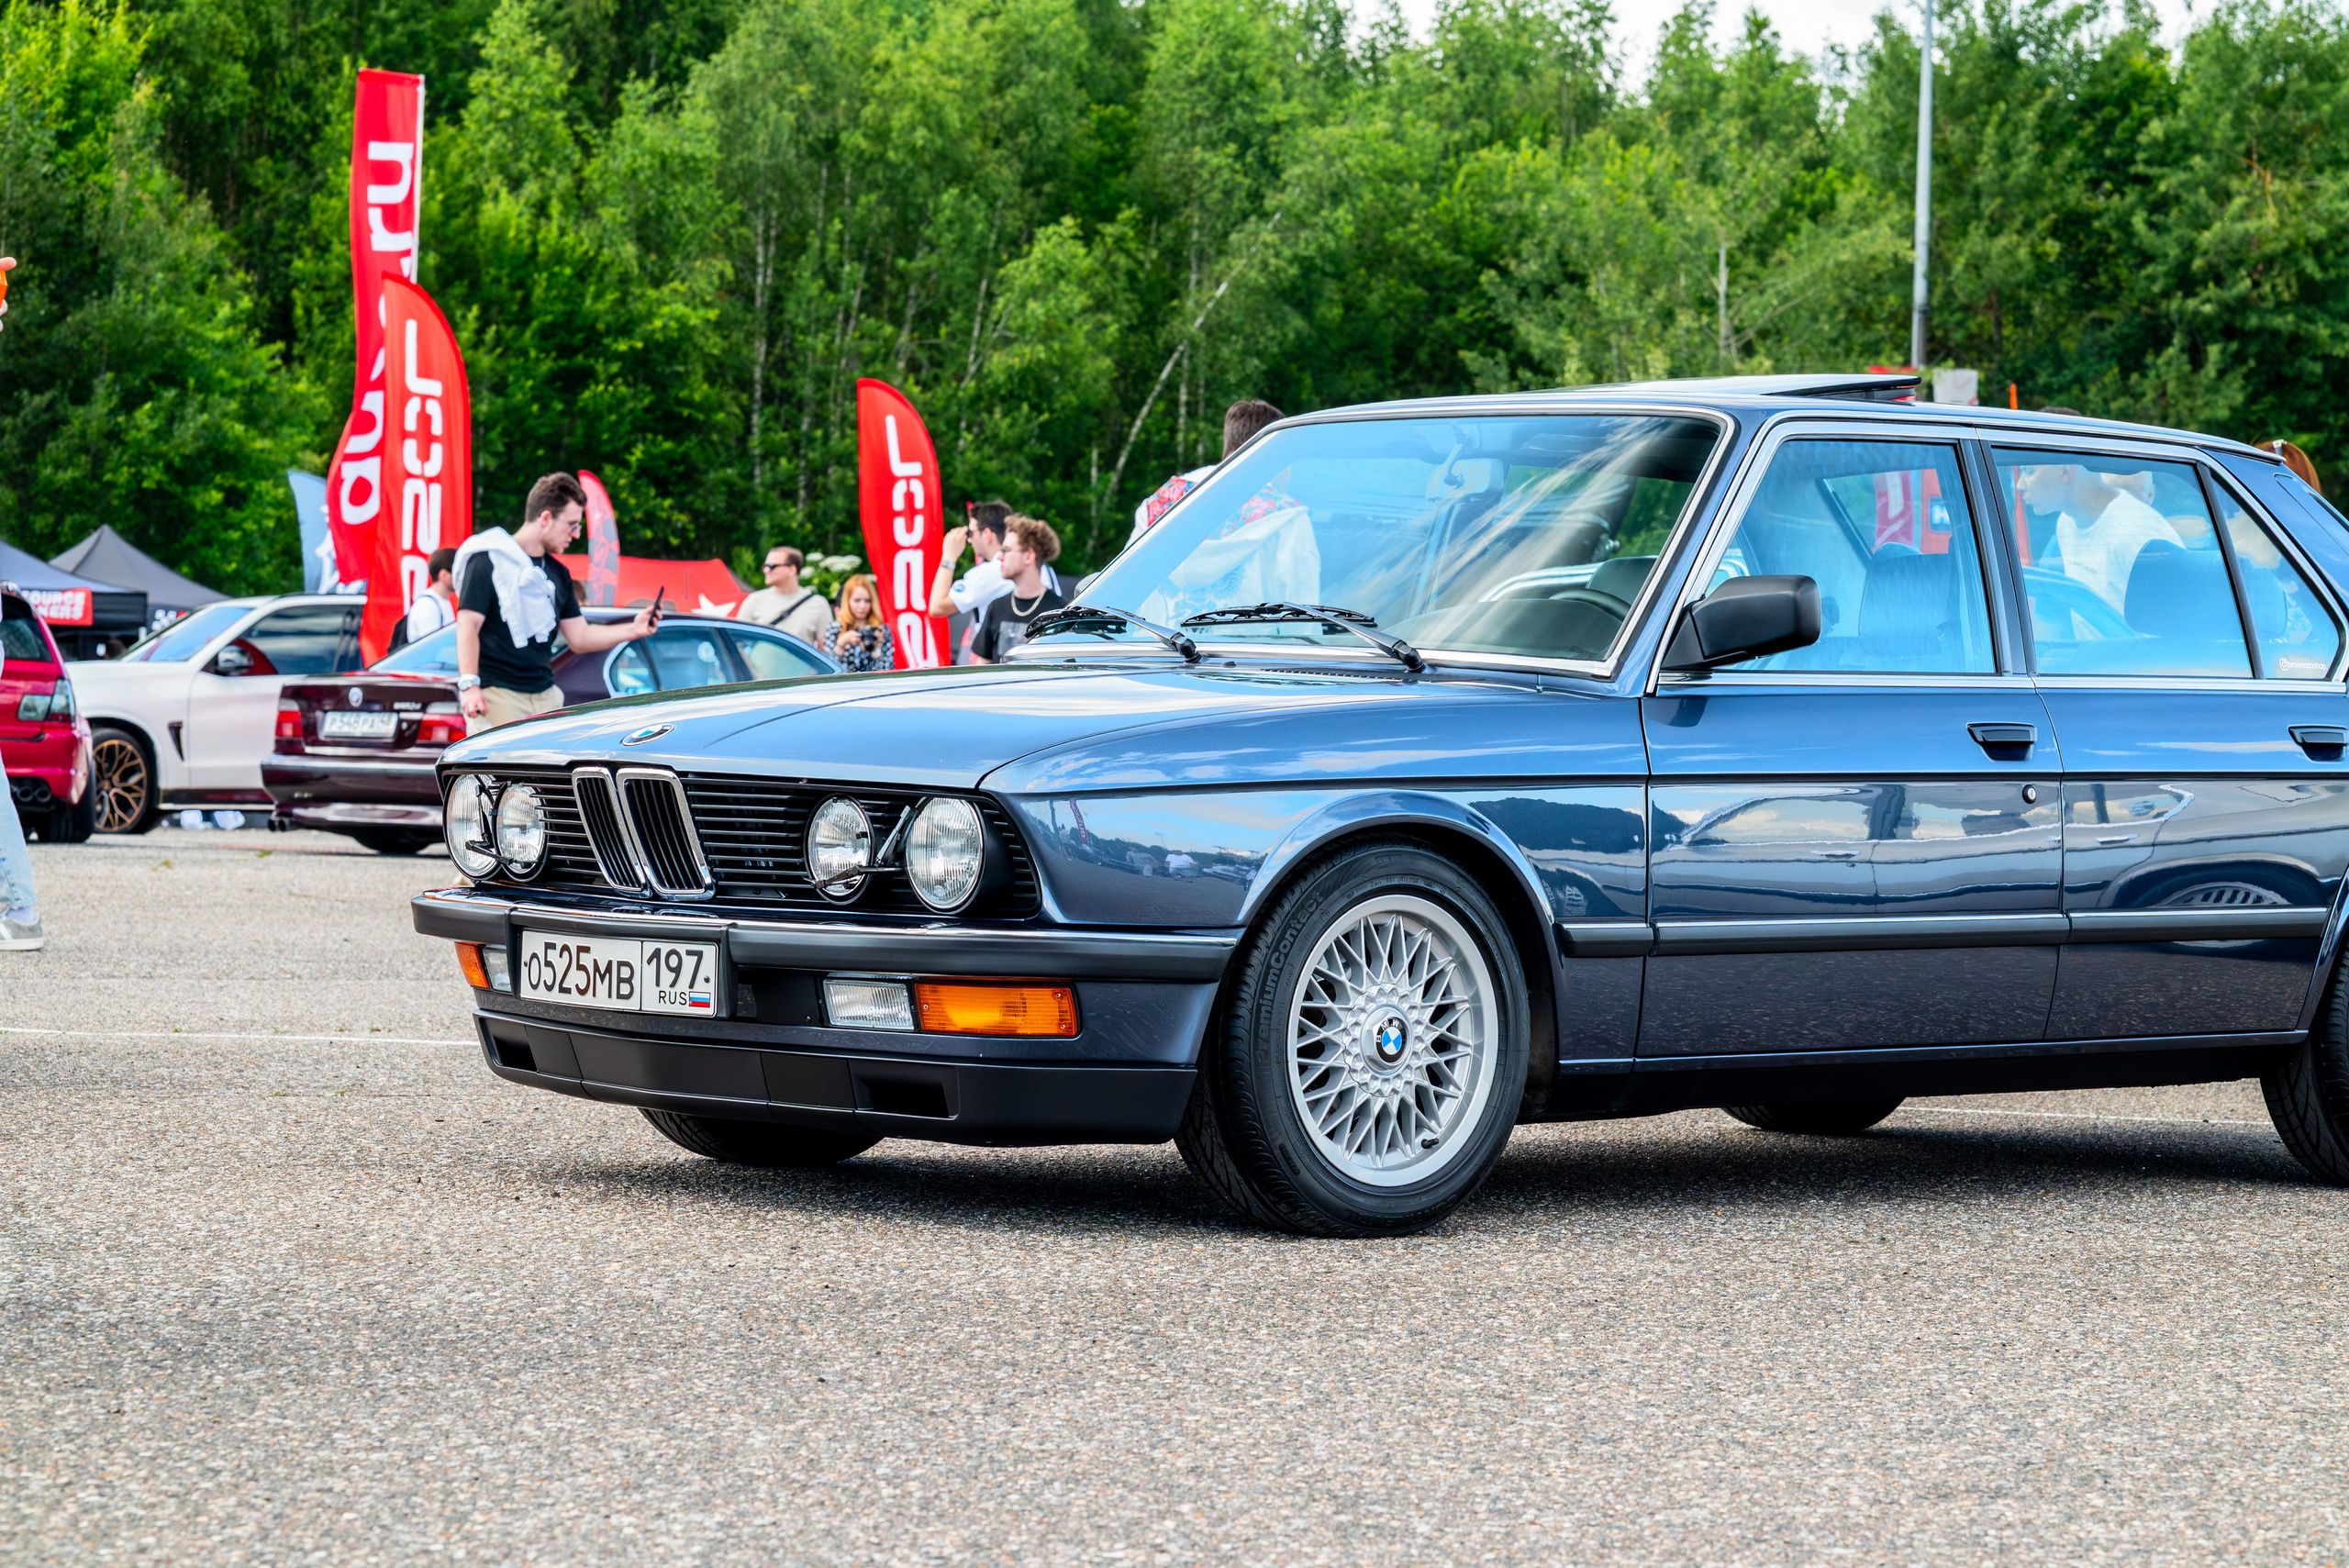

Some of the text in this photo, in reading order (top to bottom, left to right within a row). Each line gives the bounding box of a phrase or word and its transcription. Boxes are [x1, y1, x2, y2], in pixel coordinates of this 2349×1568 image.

[340, 139, 415, 526] au.ru
[646, 948, 704, 988] 197
[658, 991, 687, 1006] RUS
[1375, 1018, 1400, 1043] BMW
